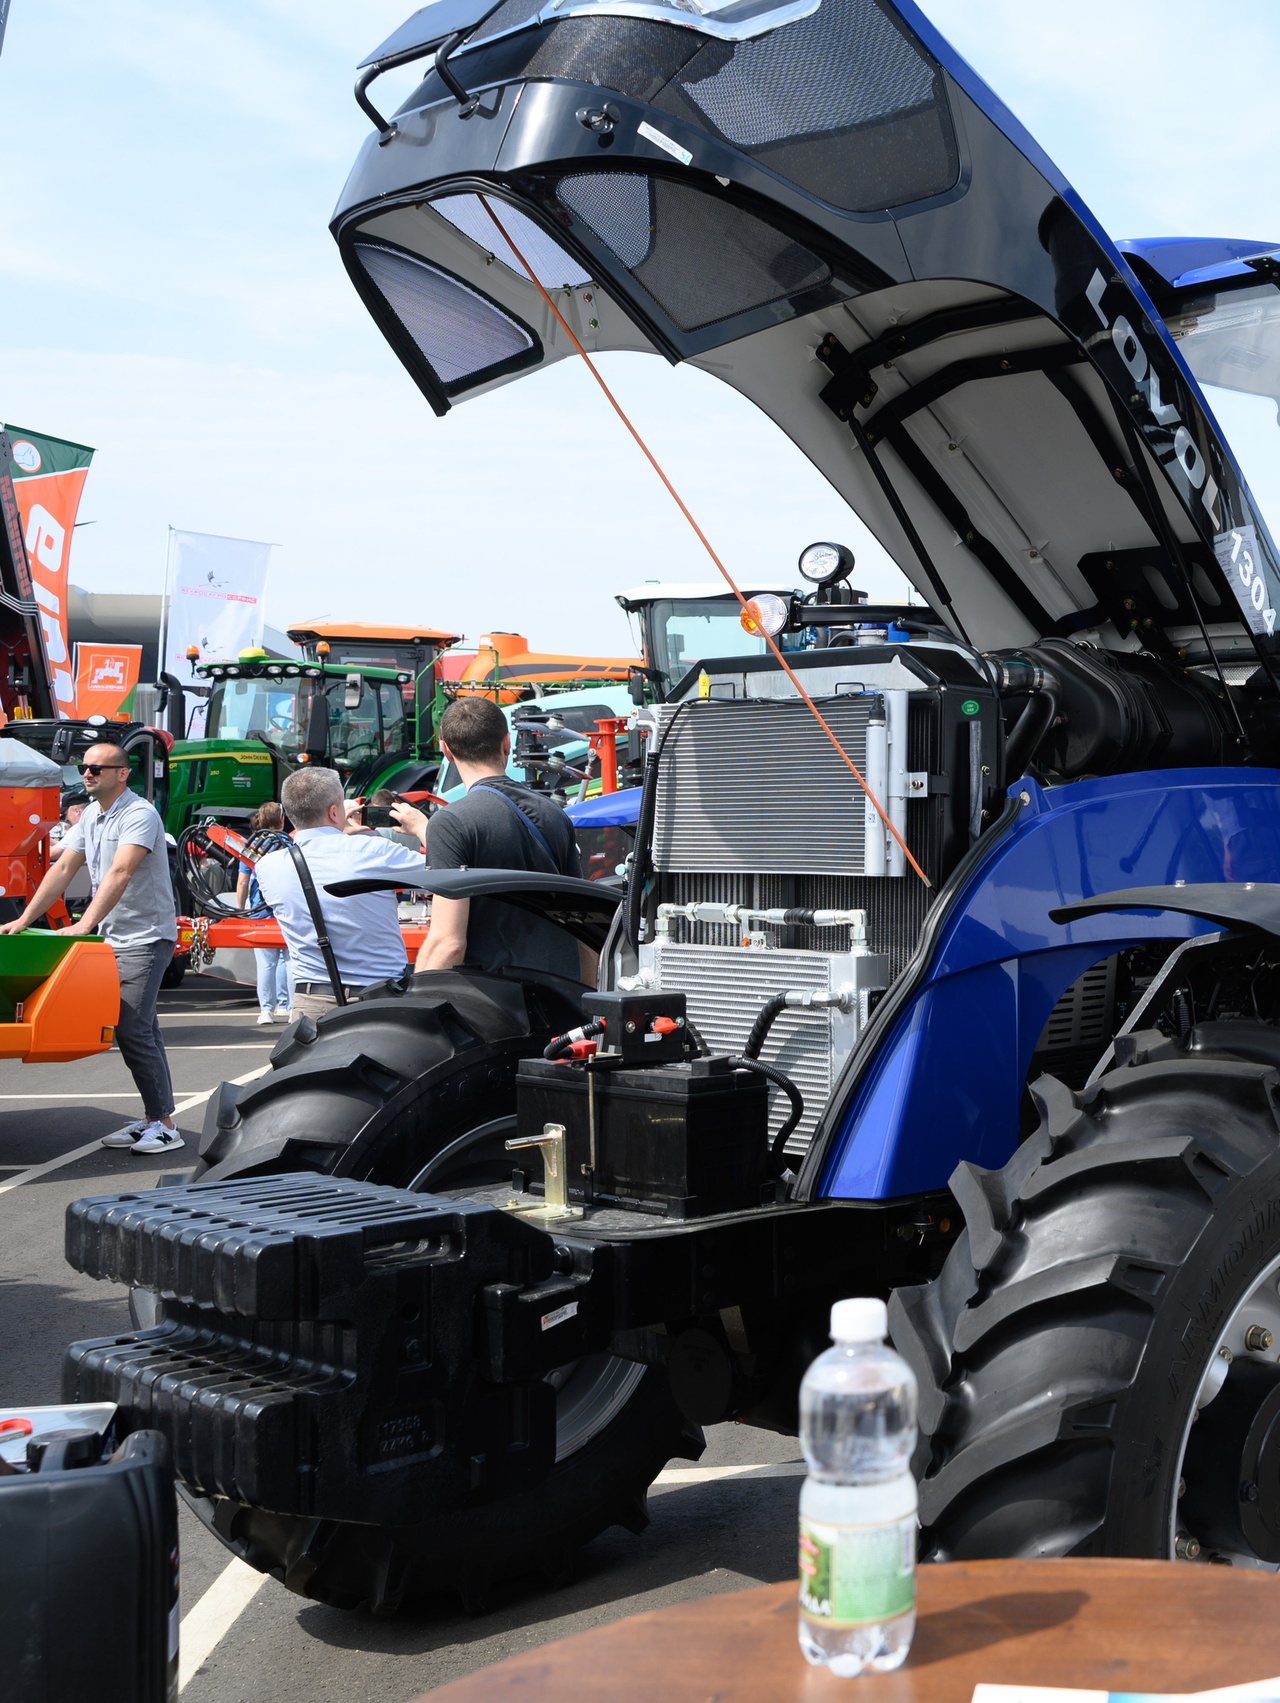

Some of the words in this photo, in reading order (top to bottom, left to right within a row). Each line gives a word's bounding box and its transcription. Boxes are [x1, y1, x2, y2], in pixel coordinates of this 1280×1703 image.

[1085, 267, 1221, 531] LOVOL
[0, 474, 30, 599] MANITOU
[1231, 530, 1277, 637] 1304
